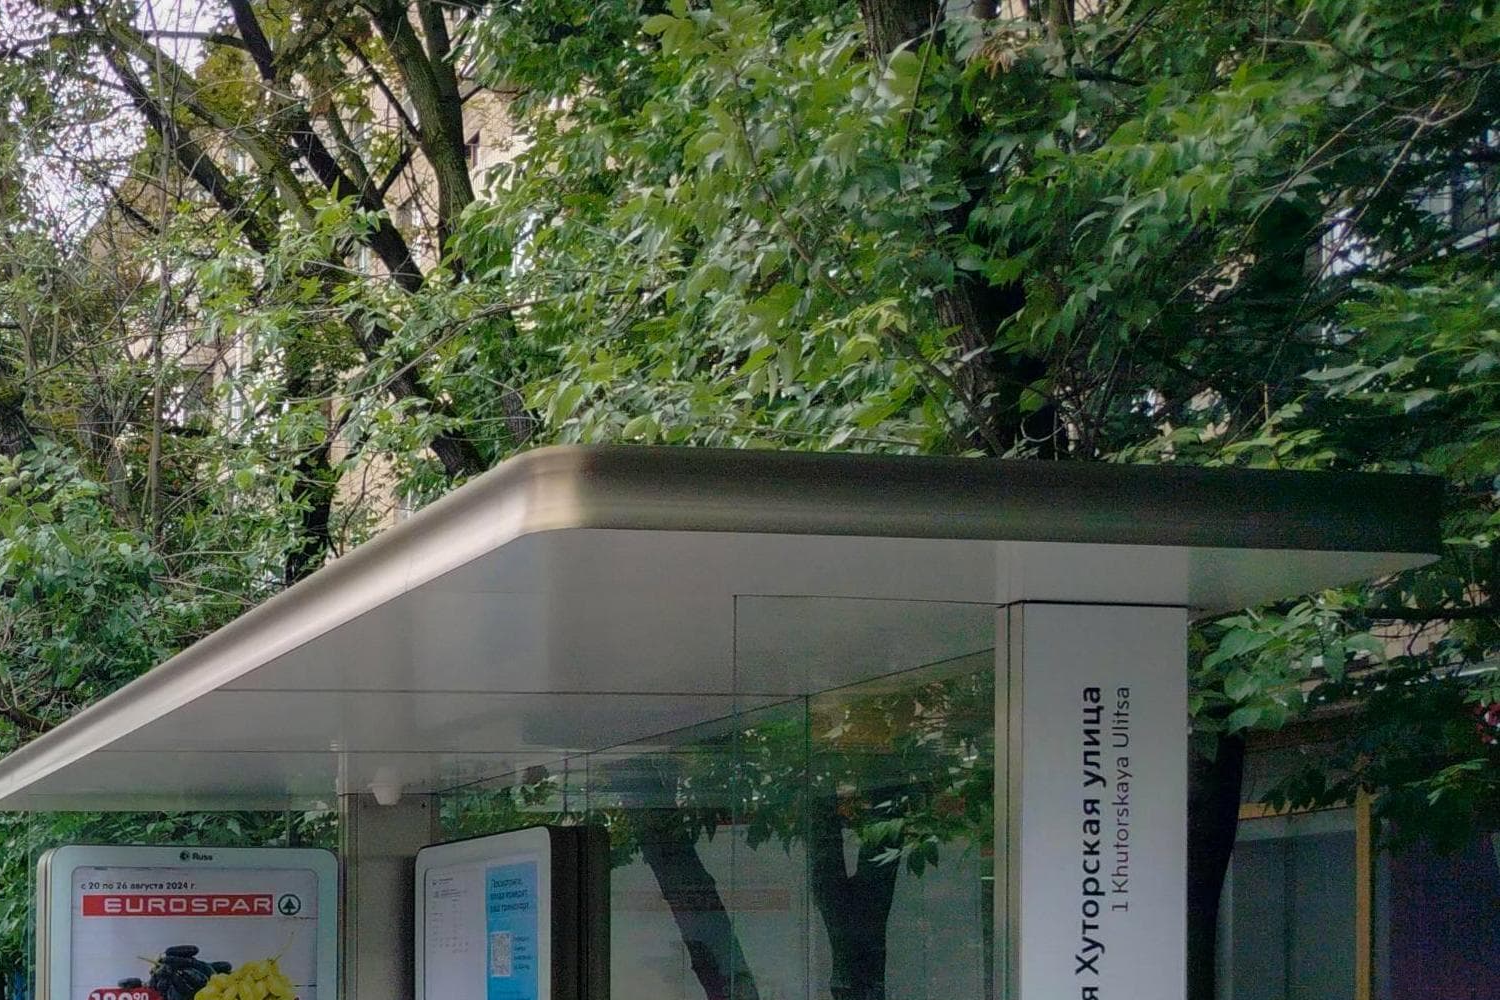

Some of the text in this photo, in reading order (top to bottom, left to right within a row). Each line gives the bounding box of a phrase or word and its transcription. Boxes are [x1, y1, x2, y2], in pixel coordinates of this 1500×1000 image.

[1083, 686, 1107, 788] улица
[1111, 687, 1130, 748] Ulitsa
[1111, 756, 1132, 894] Khutorskaya
[88, 881, 100, 890] 20
[116, 881, 128, 890] 26
[130, 882, 164, 892] августа
[166, 880, 189, 890] 2024
[103, 896, 272, 914] EUROSPAR
[1075, 799, 1106, 976] Хуторская
